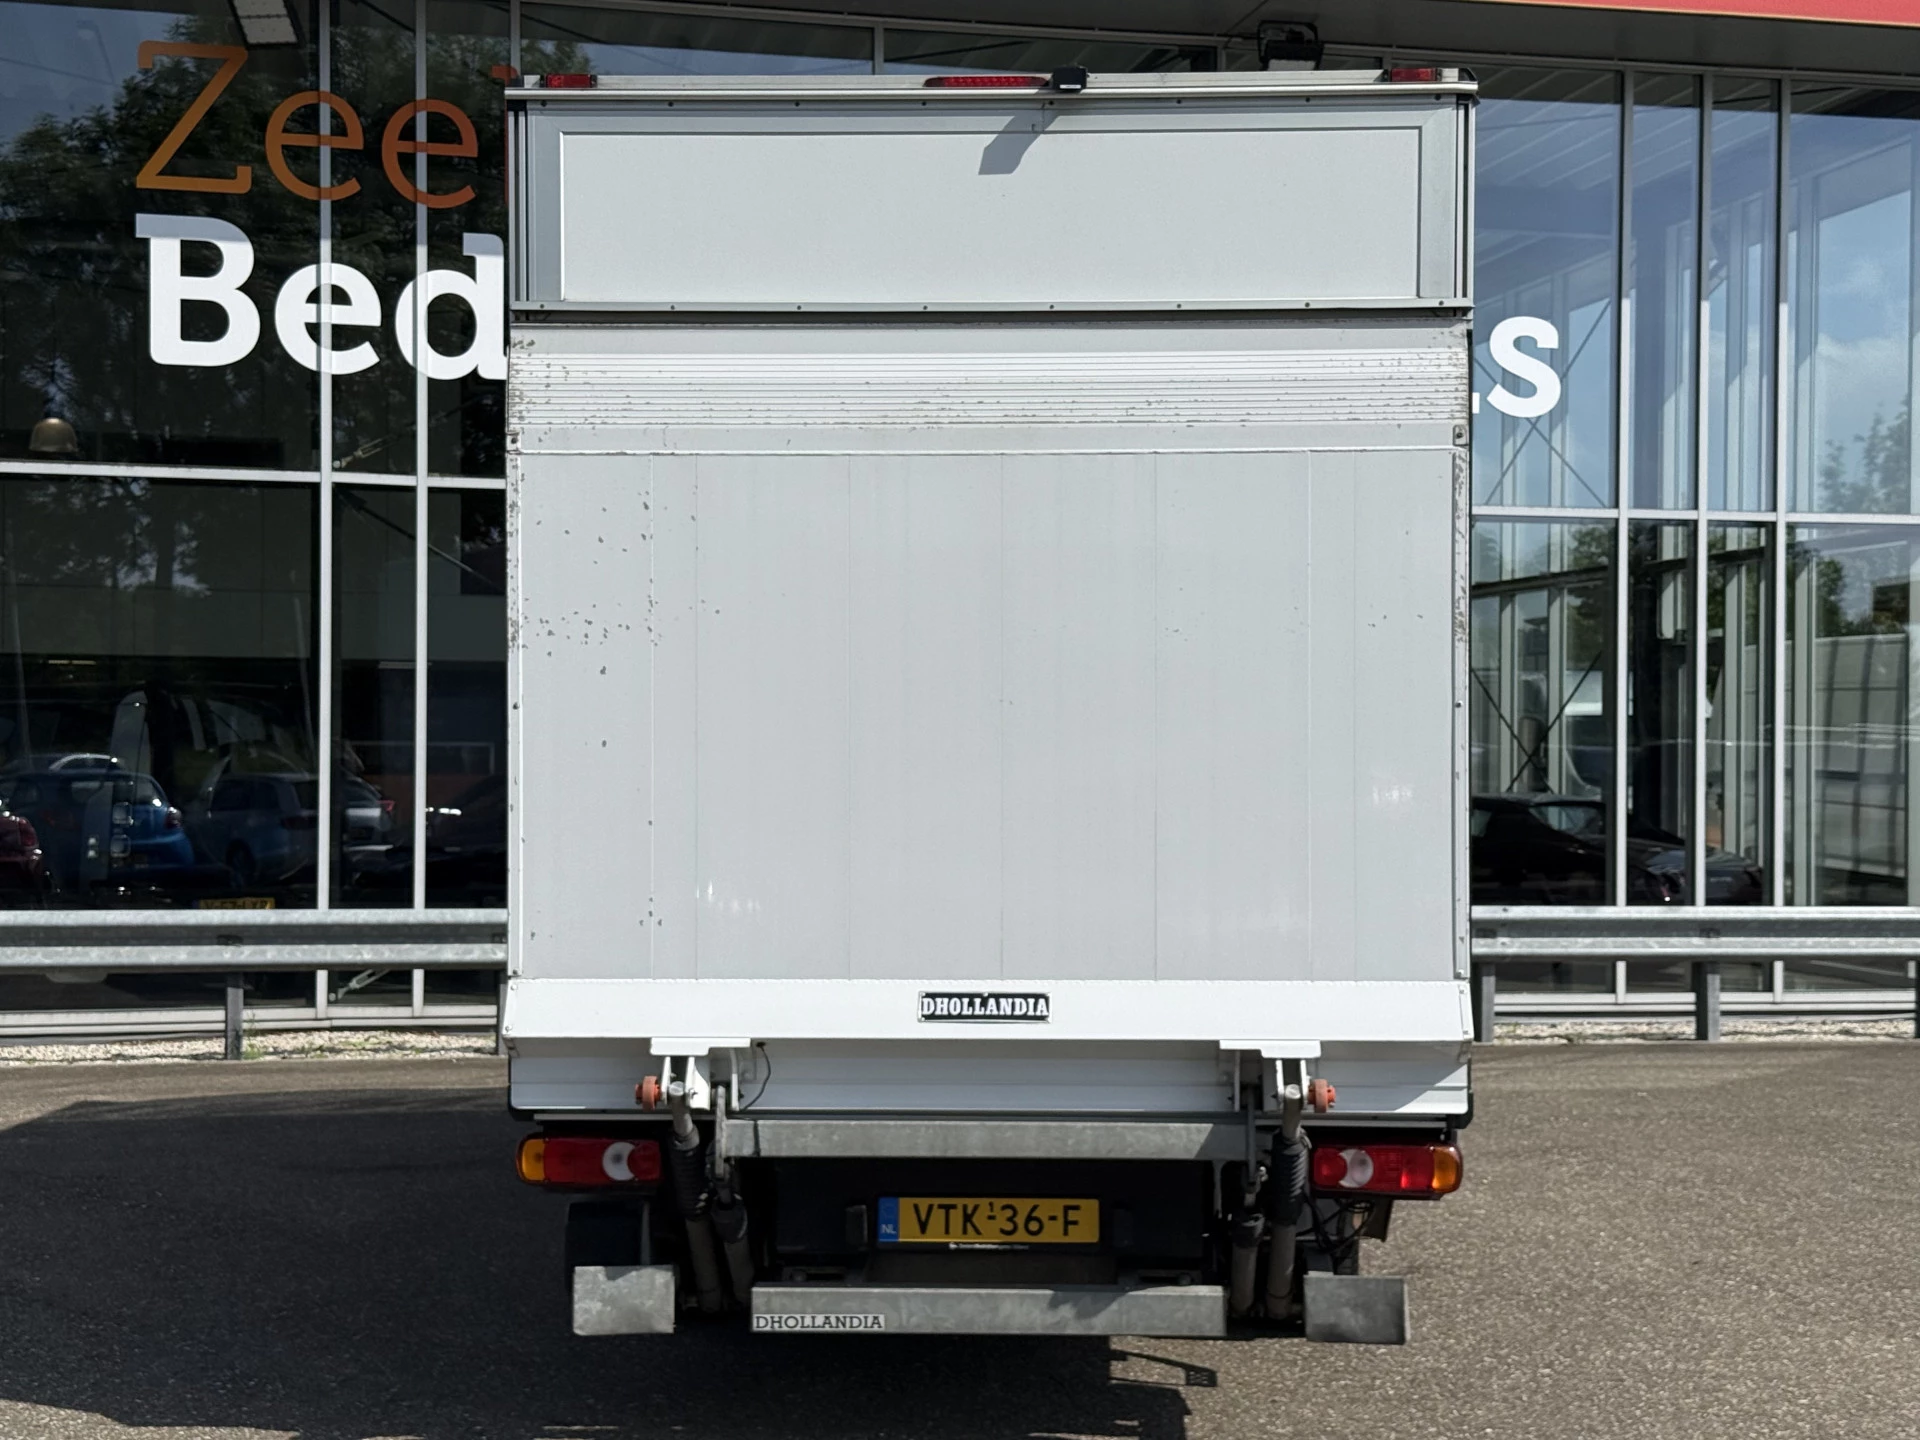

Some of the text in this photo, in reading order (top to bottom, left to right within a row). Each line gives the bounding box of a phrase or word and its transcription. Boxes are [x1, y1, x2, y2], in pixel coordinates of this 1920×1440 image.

[1472, 315, 1562, 418] s
[921, 997, 1049, 1016] DHOLLANDIA
[881, 1223, 897, 1235] NL
[755, 1315, 883, 1329] DHOLLANDIA
